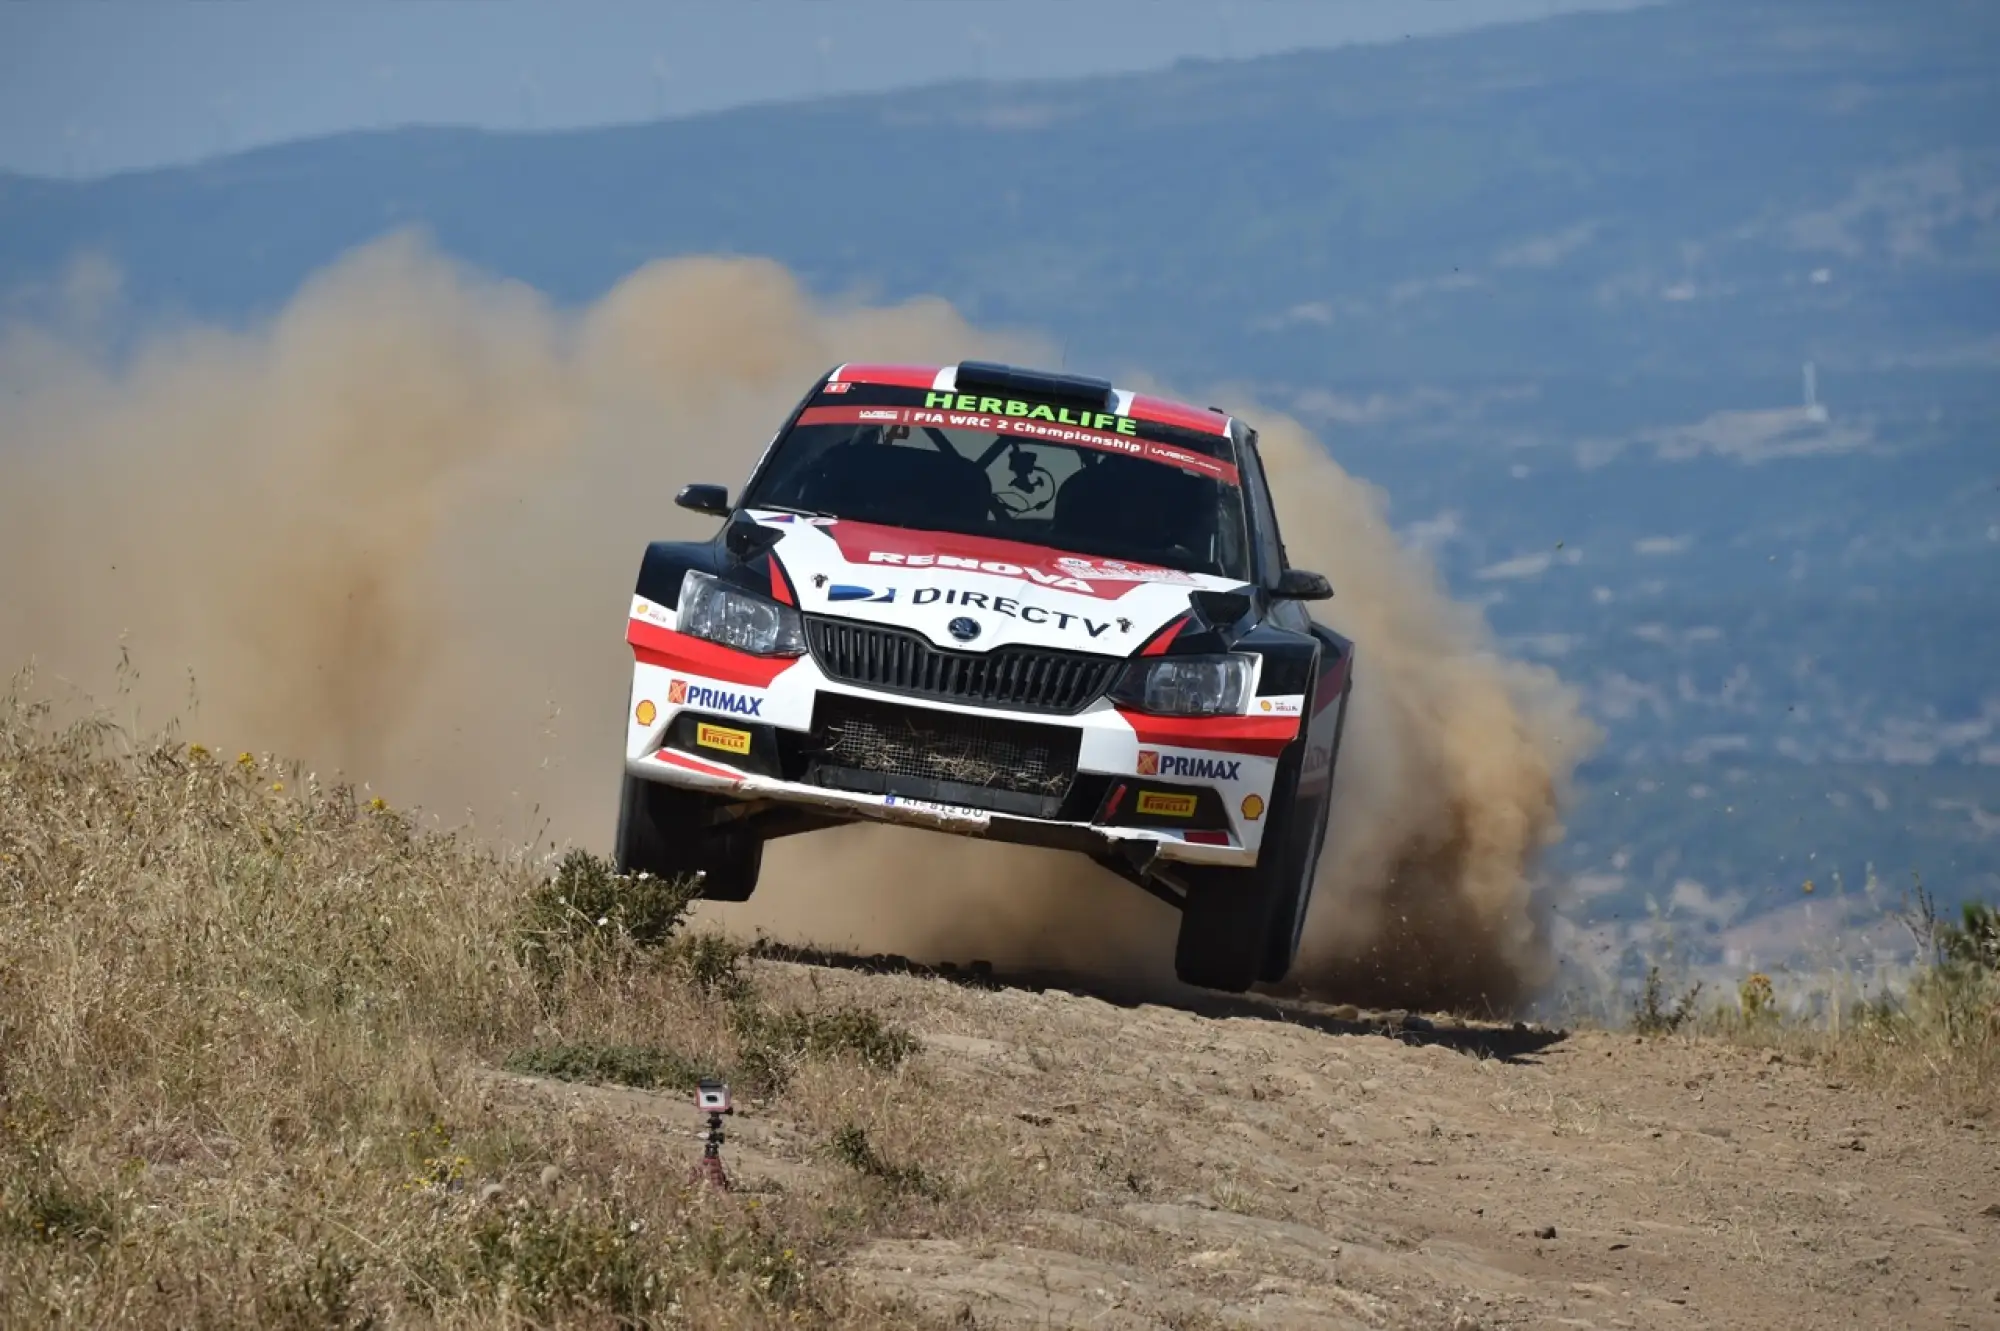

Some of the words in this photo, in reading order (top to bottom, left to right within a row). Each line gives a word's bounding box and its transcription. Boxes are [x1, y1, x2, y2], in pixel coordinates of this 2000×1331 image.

[924, 391, 1137, 436] HERBALIFE
[913, 412, 944, 423] FIA
[950, 415, 991, 427] WRC
[997, 421, 1009, 430] 2
[1013, 421, 1141, 452] Championship
[868, 551, 1095, 593] RENOVA
[912, 588, 1112, 638] DIRECTV
[687, 685, 764, 717] PRIMAX
[702, 727, 745, 749] PIRELLI
[1160, 755, 1241, 780] PRIMAX
[1143, 795, 1192, 813] PIRELLI
